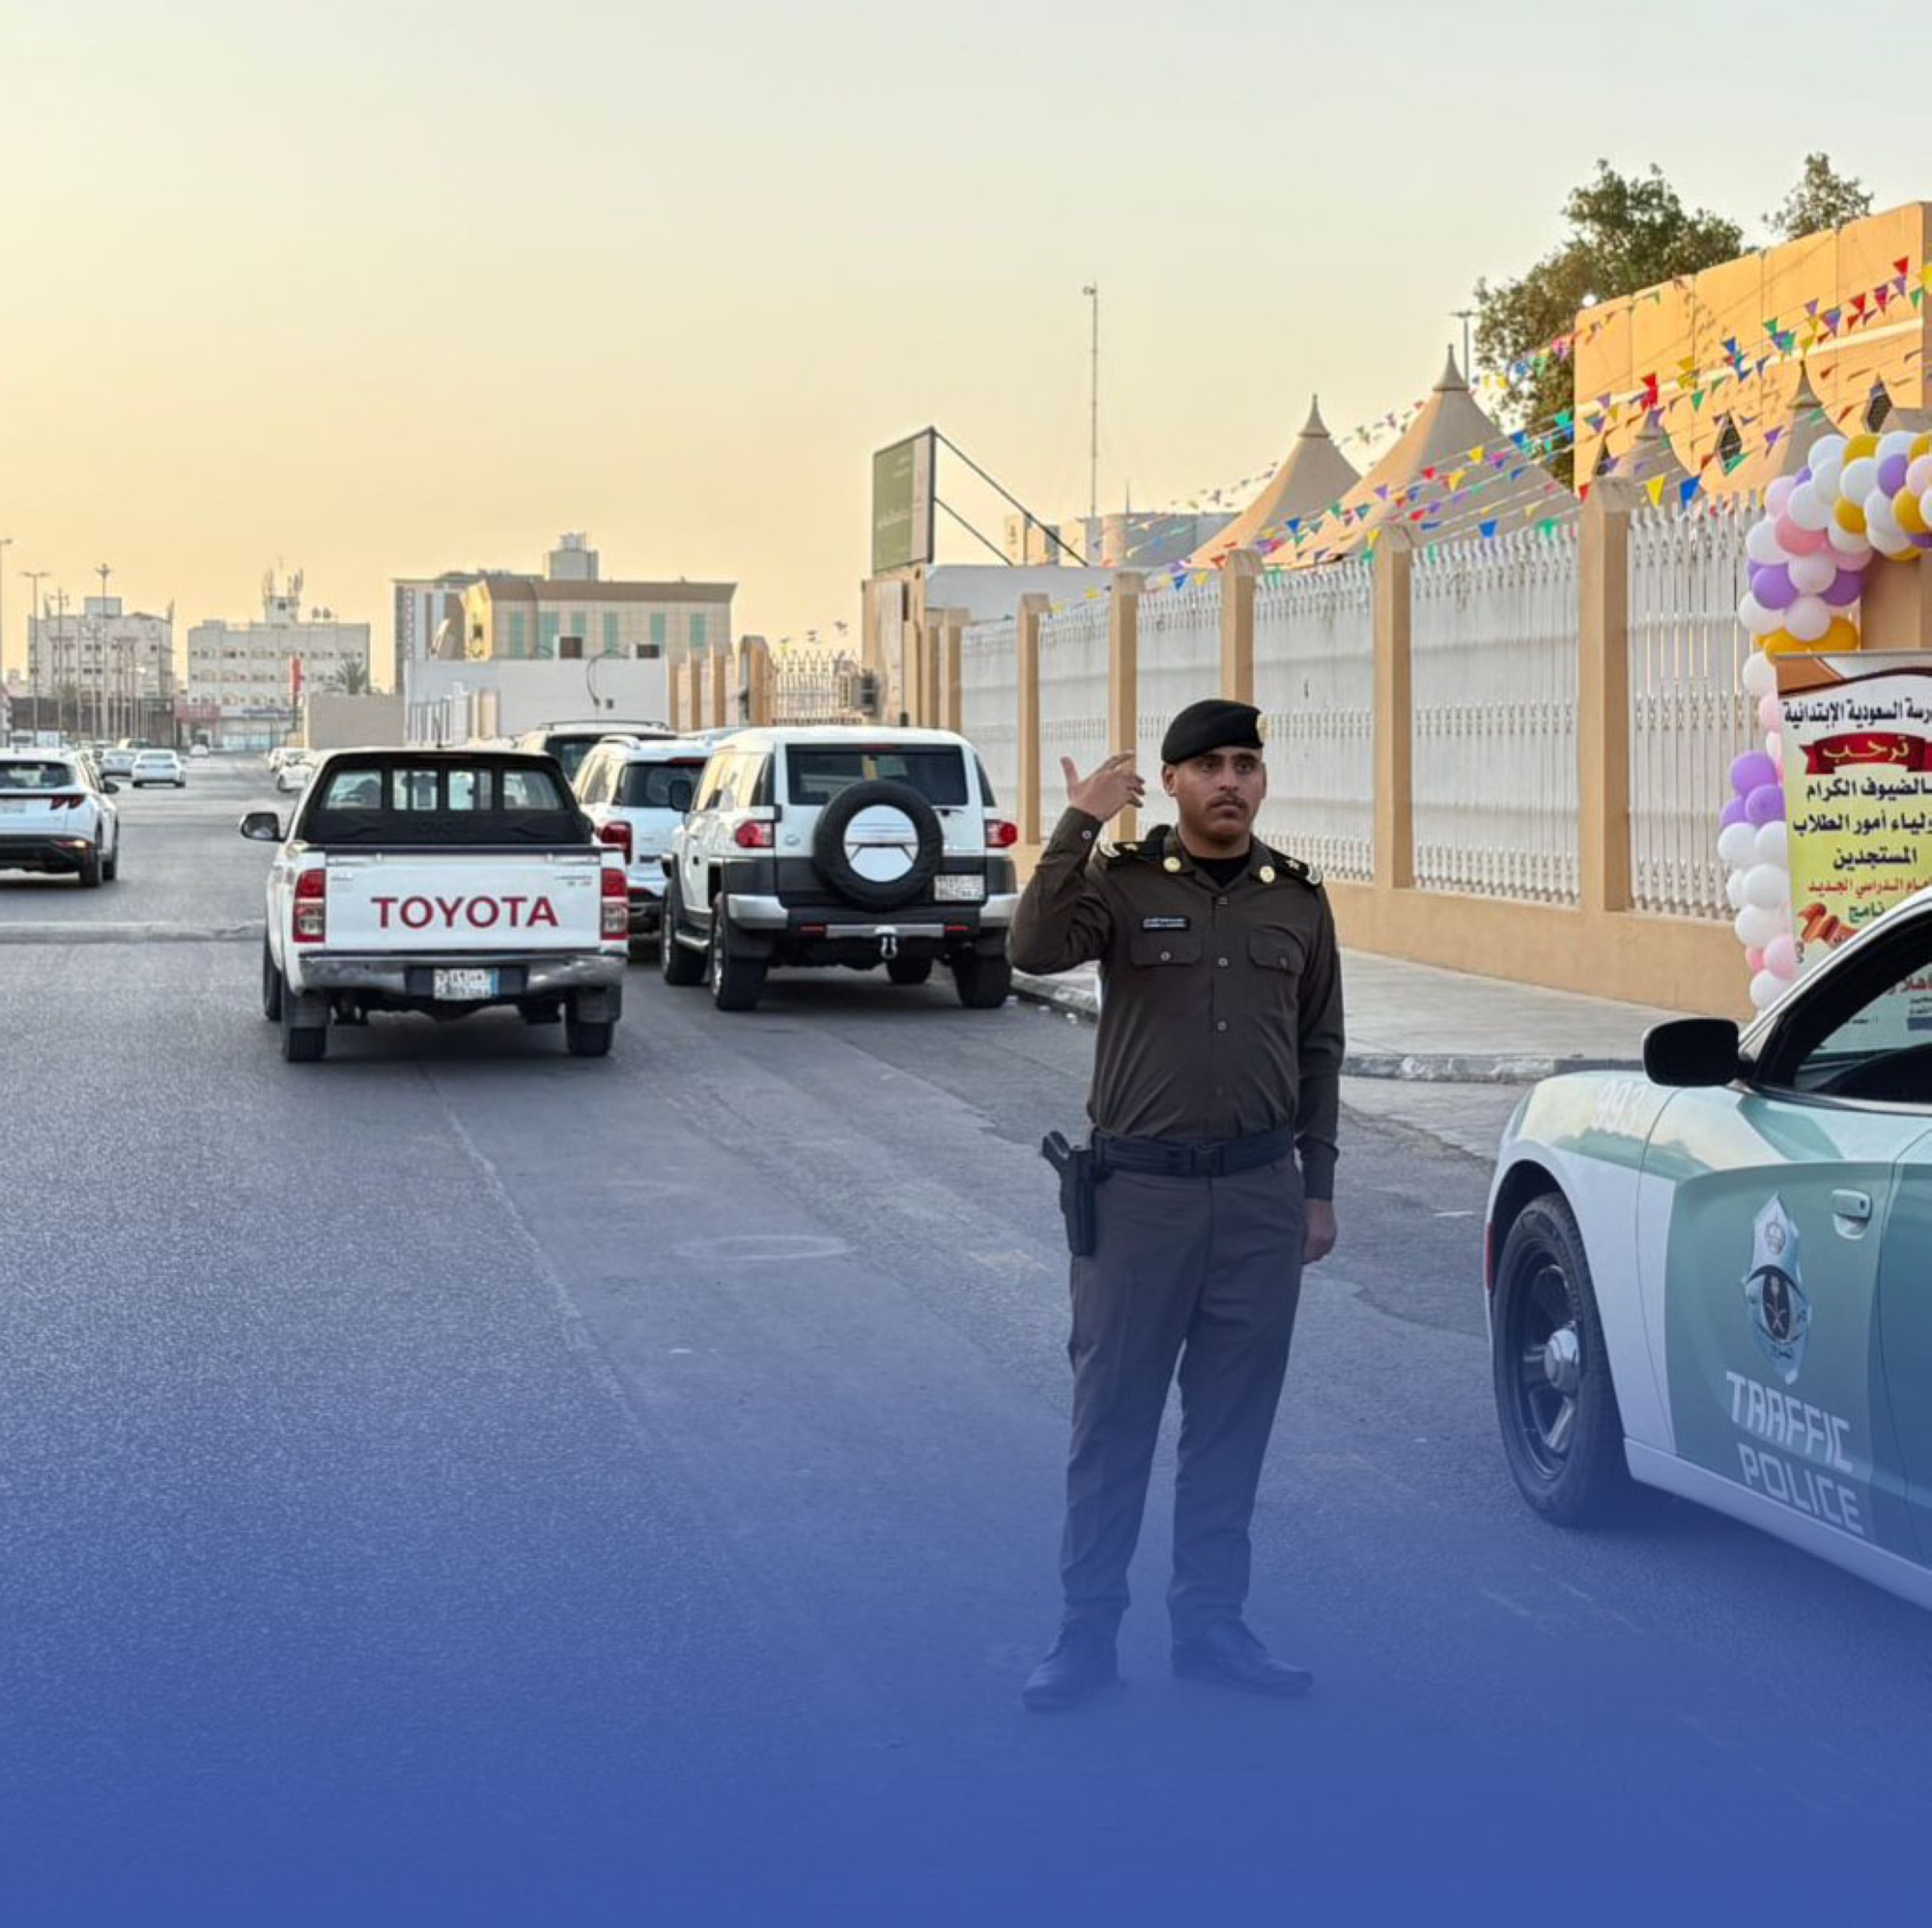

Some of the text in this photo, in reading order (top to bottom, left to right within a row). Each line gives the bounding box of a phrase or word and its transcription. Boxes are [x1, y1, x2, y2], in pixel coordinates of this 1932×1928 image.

[1846, 697, 1902, 729] السعودية
[1822, 735, 1909, 763] ترحب
[1805, 778, 1857, 802] الكرام
[1793, 813, 1850, 836] الطلاب
[1853, 808, 1887, 835] أمور
[1833, 845, 1918, 870] المستجدين
[370, 895, 558, 929] TOYOTA
[1848, 901, 1887, 923] نامج
[1726, 1371, 1855, 1474] TRAFFIC
[1737, 1442, 1865, 1536] POLICE
